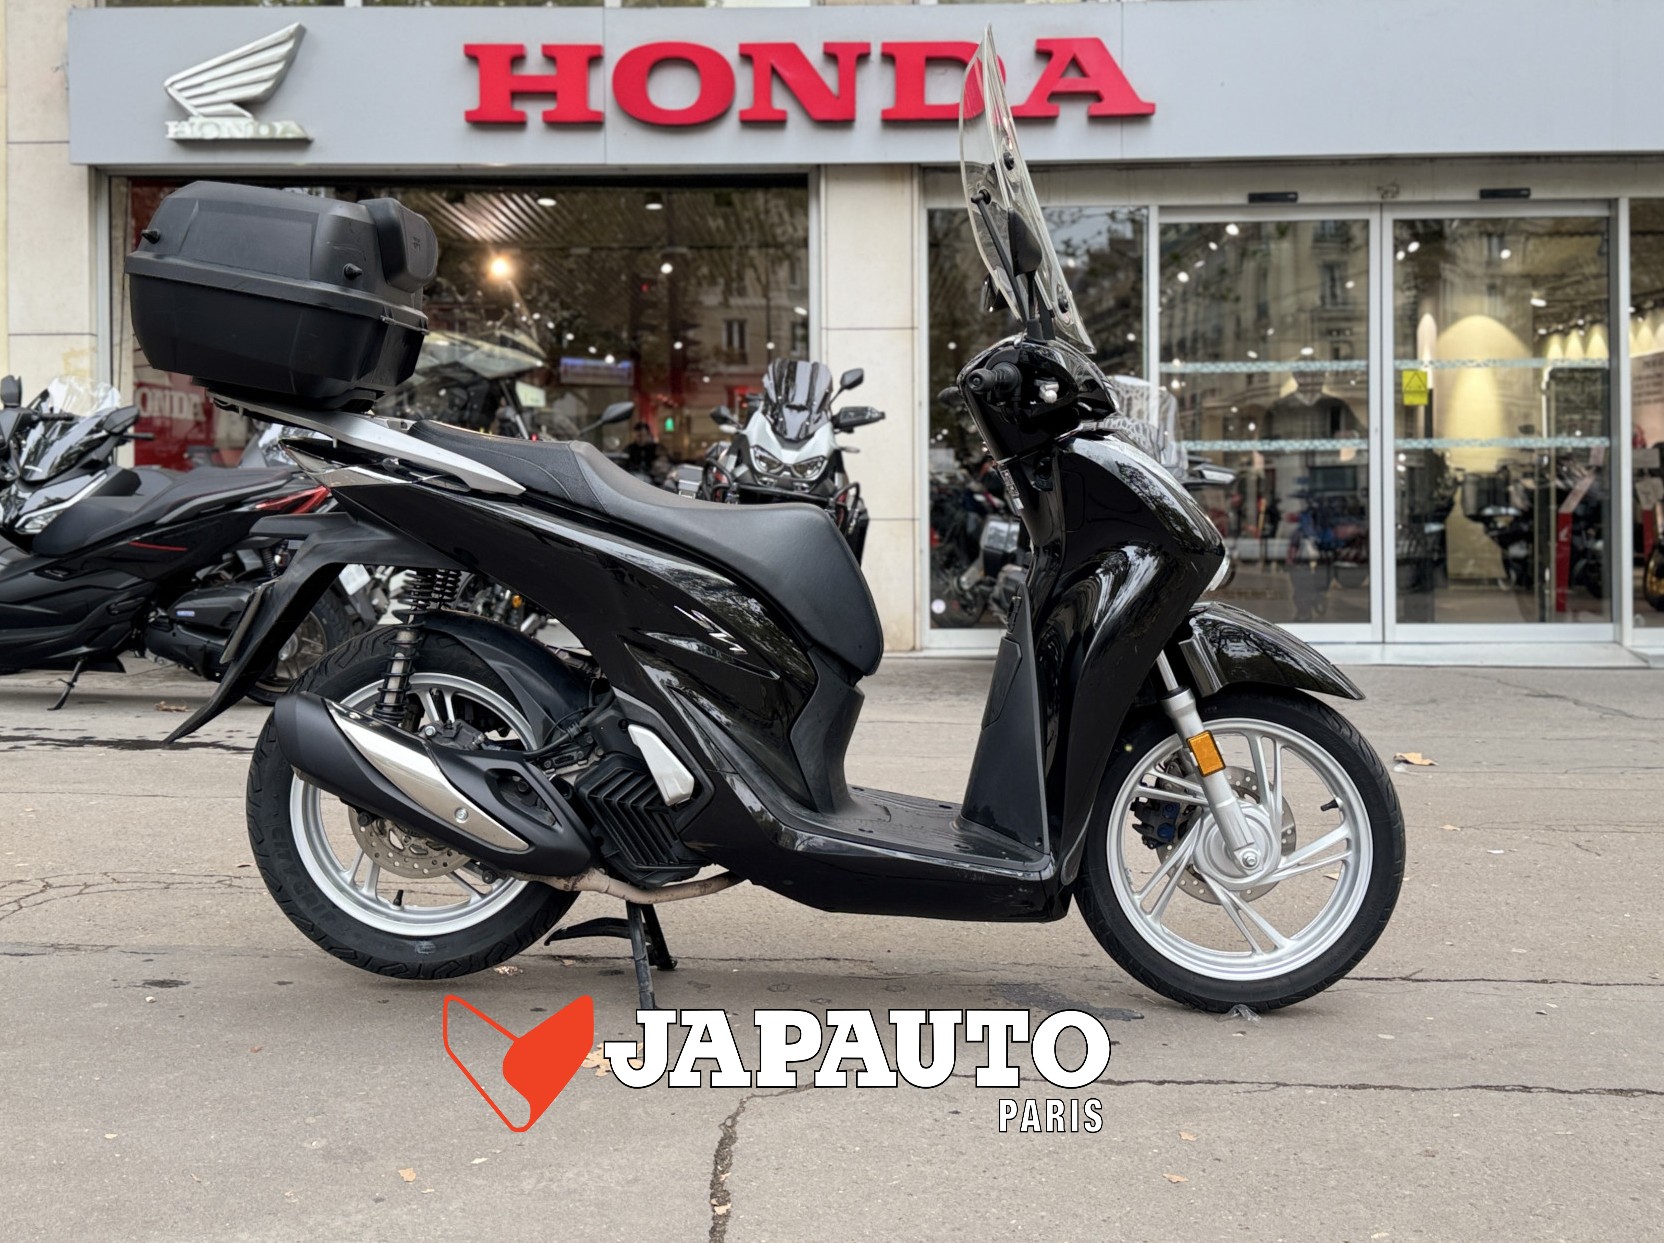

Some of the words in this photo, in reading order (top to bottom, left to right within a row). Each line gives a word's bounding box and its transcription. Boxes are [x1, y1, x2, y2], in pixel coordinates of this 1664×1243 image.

[464, 37, 1156, 126] HONDA
[165, 120, 313, 140] HONDA
[134, 386, 207, 423] ONDA
